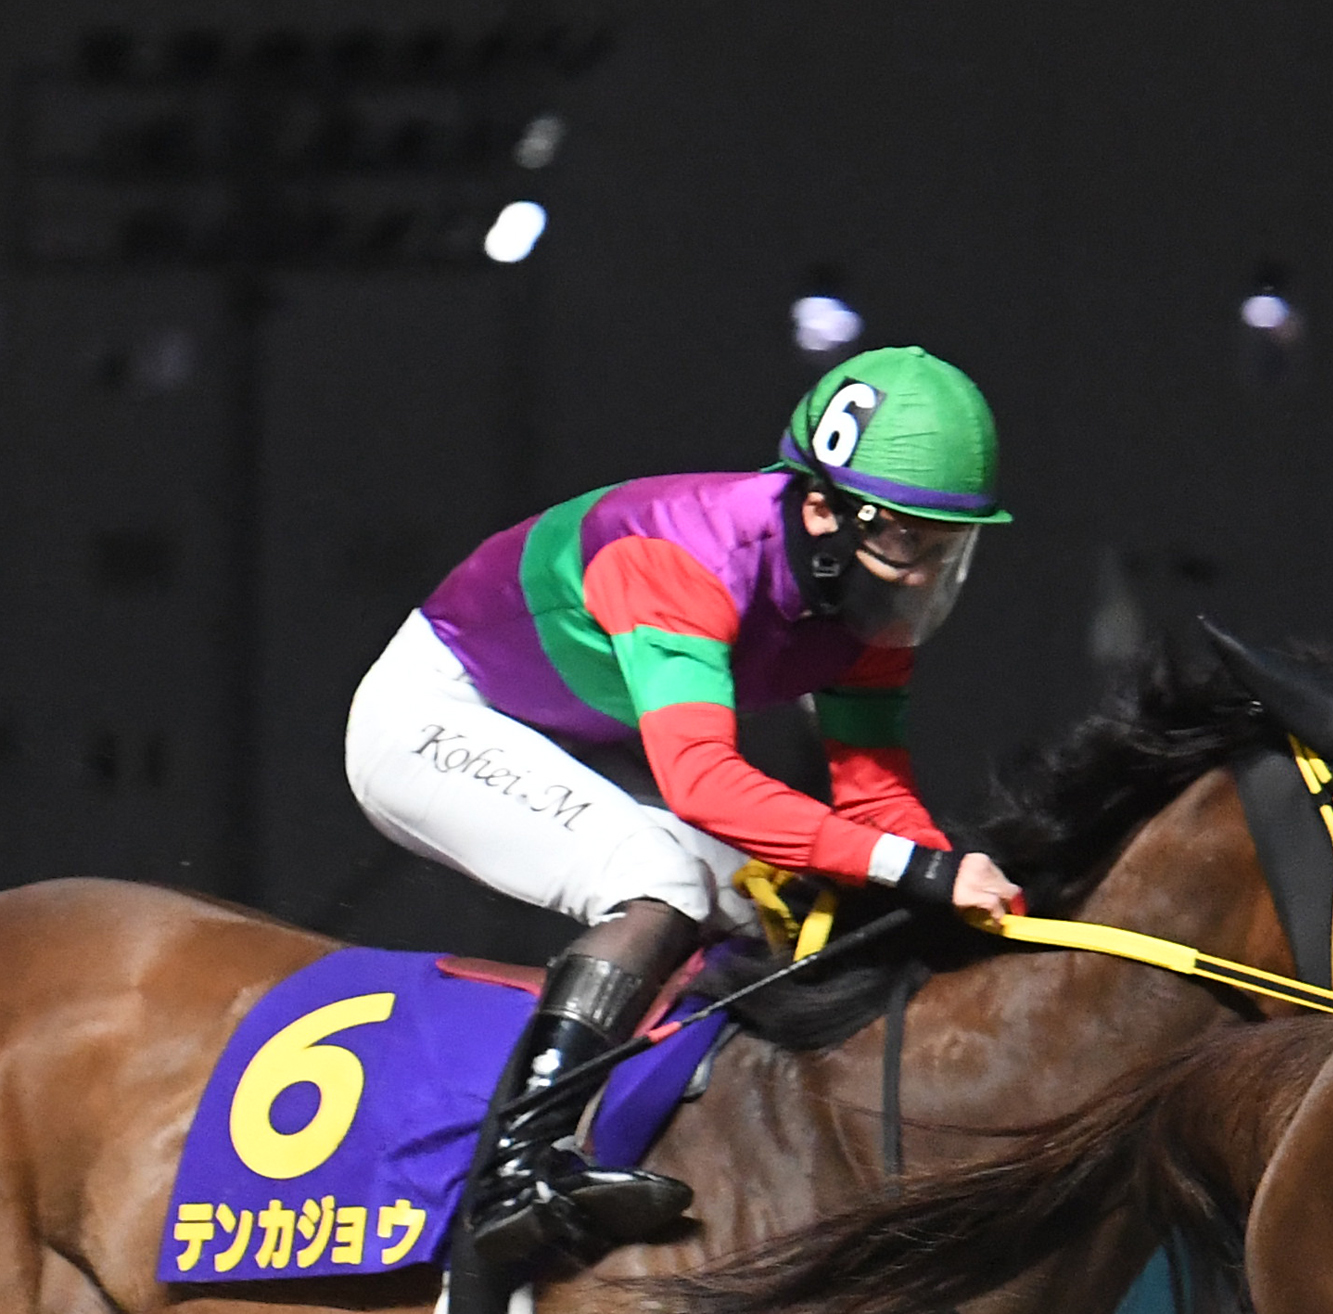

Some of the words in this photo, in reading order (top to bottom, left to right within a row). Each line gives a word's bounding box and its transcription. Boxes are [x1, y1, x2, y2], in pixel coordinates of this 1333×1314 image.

[812, 382, 877, 468] 6
[228, 991, 397, 1180] 6
[173, 1194, 428, 1273] テンカジョウ
